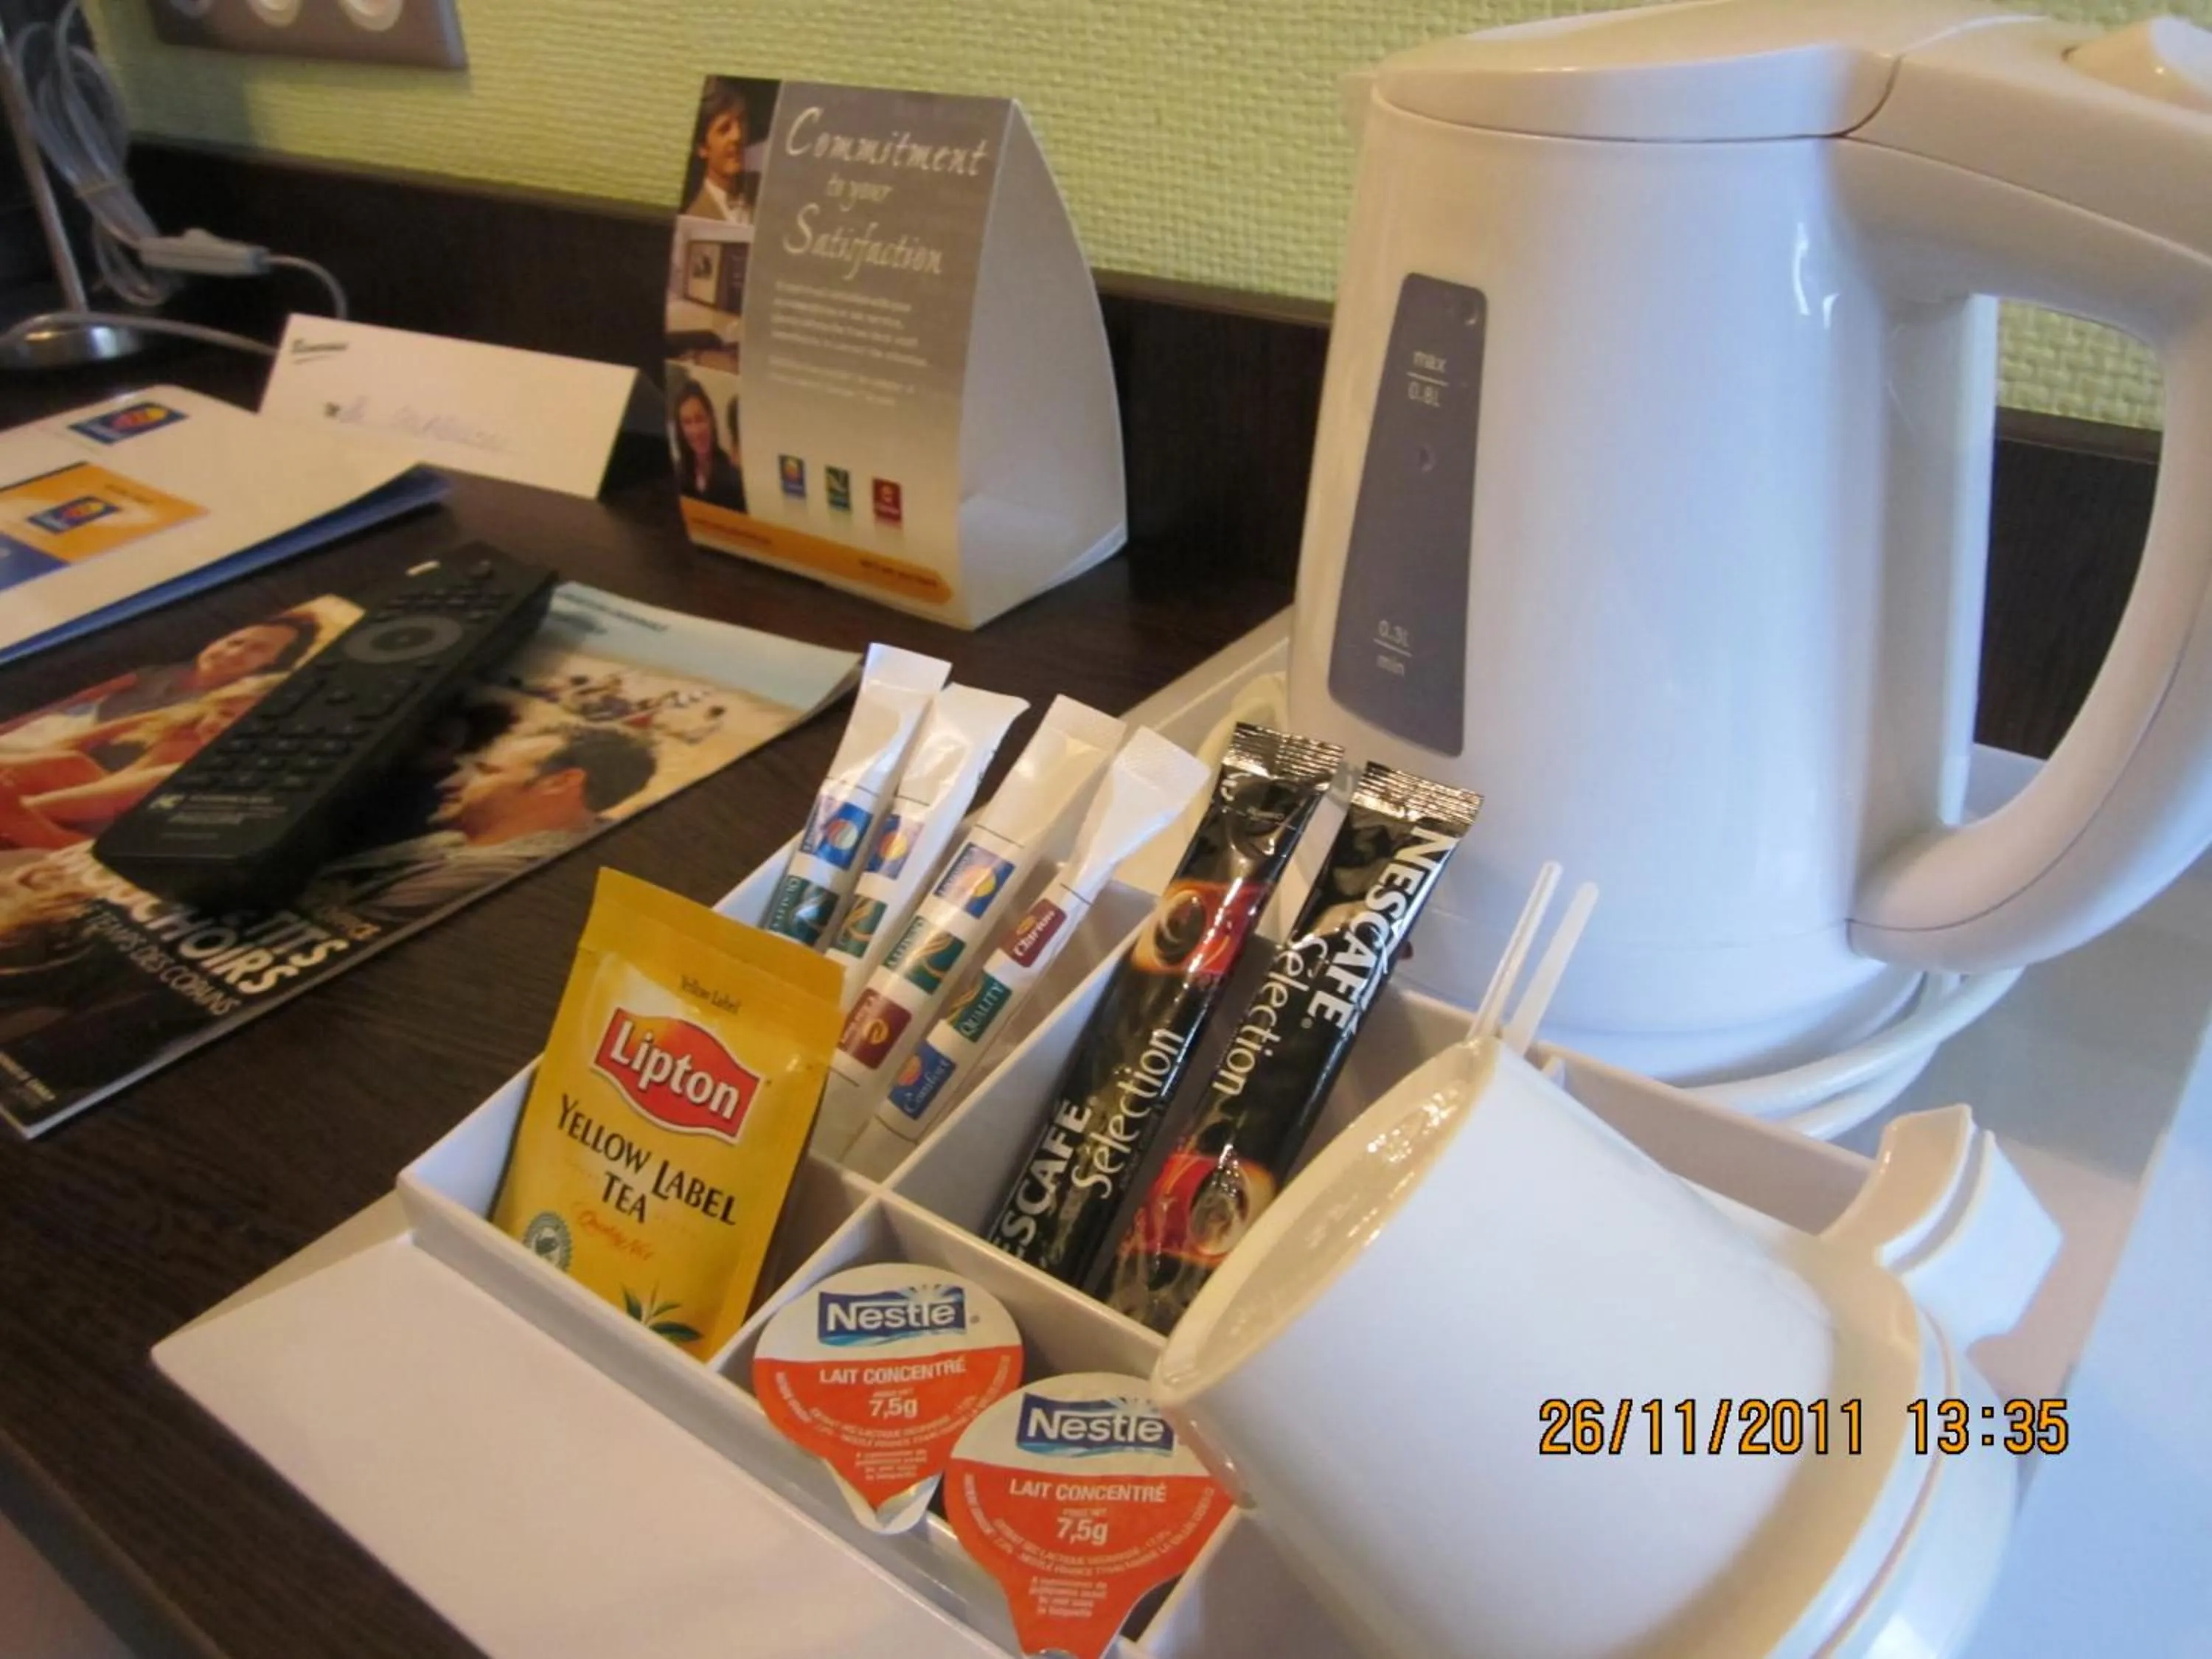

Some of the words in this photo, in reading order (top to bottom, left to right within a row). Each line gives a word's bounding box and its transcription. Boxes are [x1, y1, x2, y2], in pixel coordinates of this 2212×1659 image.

[785, 106, 987, 176] Commitment
[826, 173, 845, 198] to
[839, 180, 893, 212] your
[782, 202, 942, 280] Satisfaction
[1413, 350, 1447, 374] max
[960, 981, 1006, 1037] QUALITY
[609, 1020, 741, 1119] Lipton
[557, 1093, 651, 1173] YELLOW
[651, 1160, 737, 1225] LABEL
[602, 1170, 647, 1225] TEA
[818, 1368, 858, 1385] LAIT
[863, 1354, 967, 1385] CONCENTRÉ
[868, 1397, 919, 1419] 7,5g
[1009, 1478, 1053, 1498] LAIT
[1054, 1479, 1168, 1503] CONCENTRÉ
[1057, 1516, 1108, 1546] 7,5g
